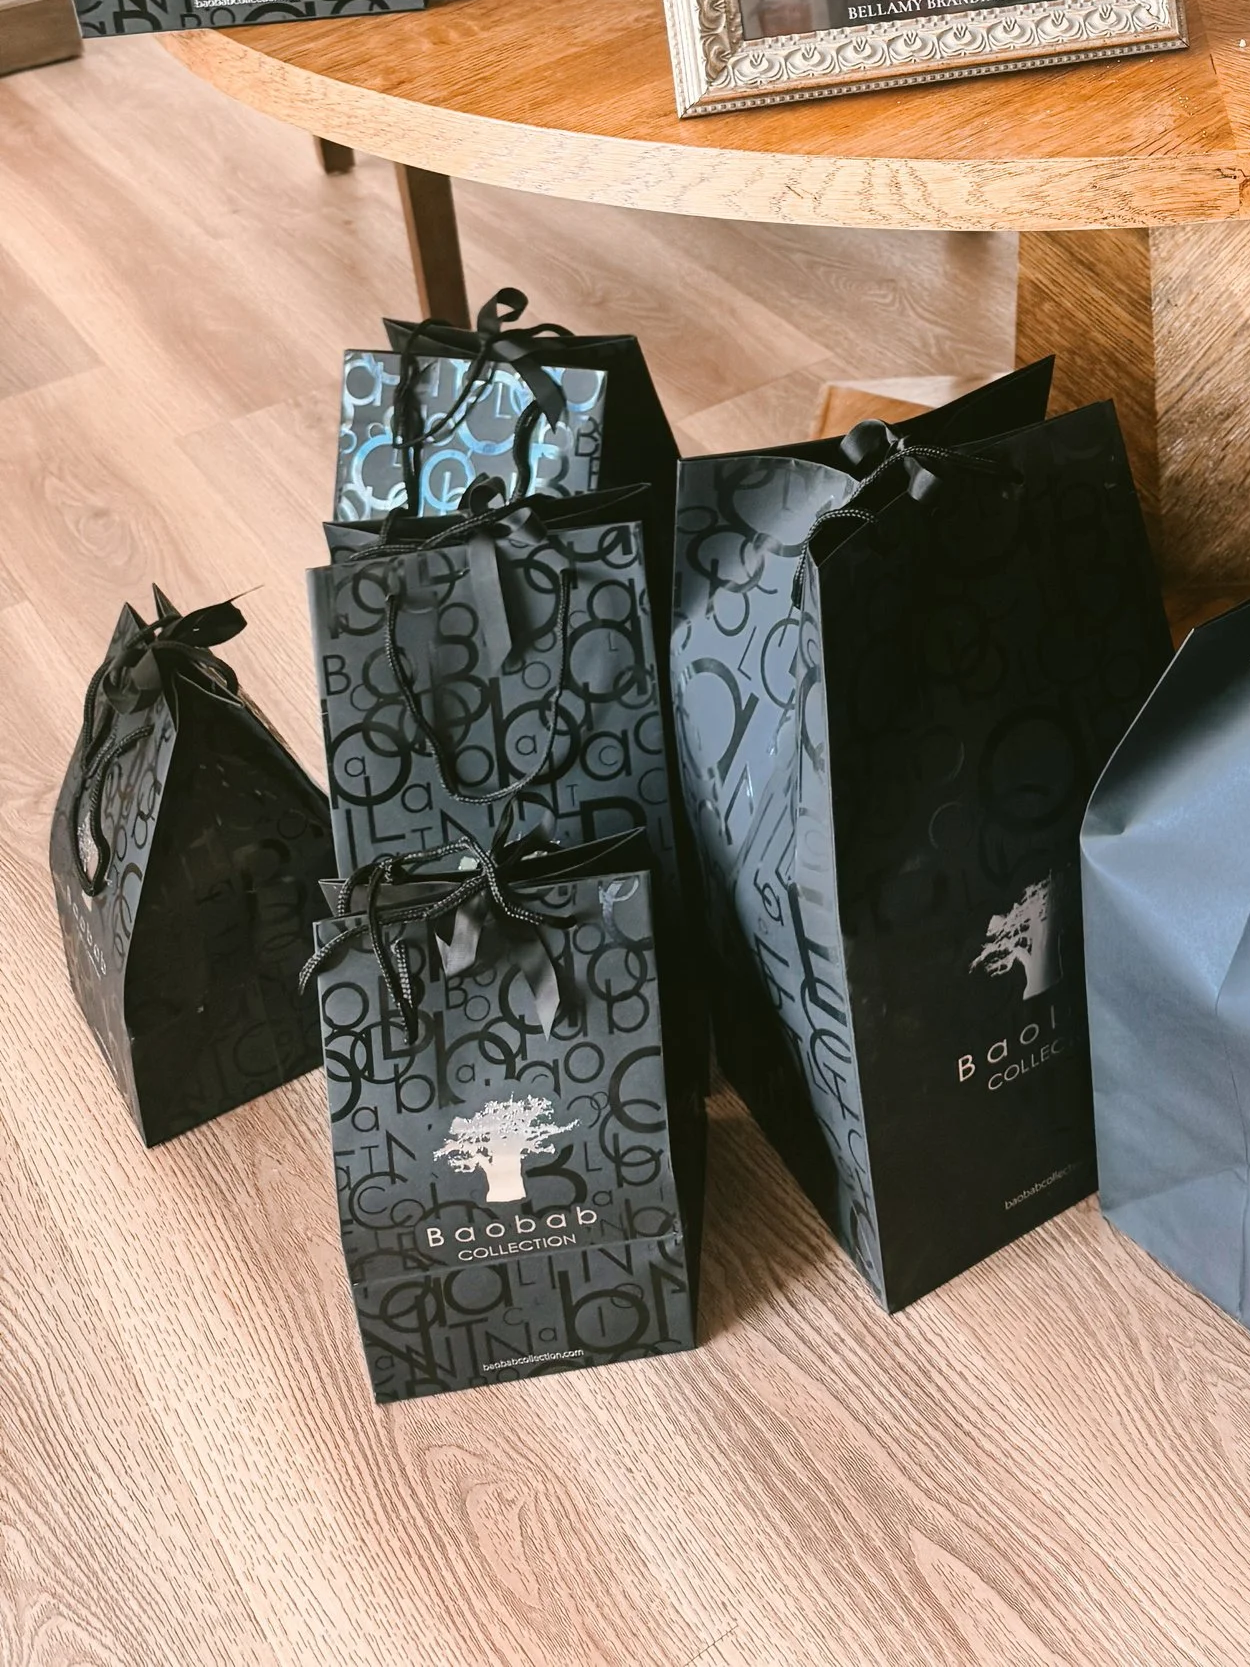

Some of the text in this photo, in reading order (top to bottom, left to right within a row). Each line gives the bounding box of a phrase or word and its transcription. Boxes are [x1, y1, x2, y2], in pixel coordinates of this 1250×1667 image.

[958, 1004, 1062, 1083] Bao
[988, 1041, 1068, 1091] COLLEC
[1004, 1162, 1080, 1212] baobabcollect
[426, 1206, 599, 1248] Baobab
[458, 1233, 577, 1262] COLLECTION
[482, 1347, 585, 1373] baobabcollection.com
